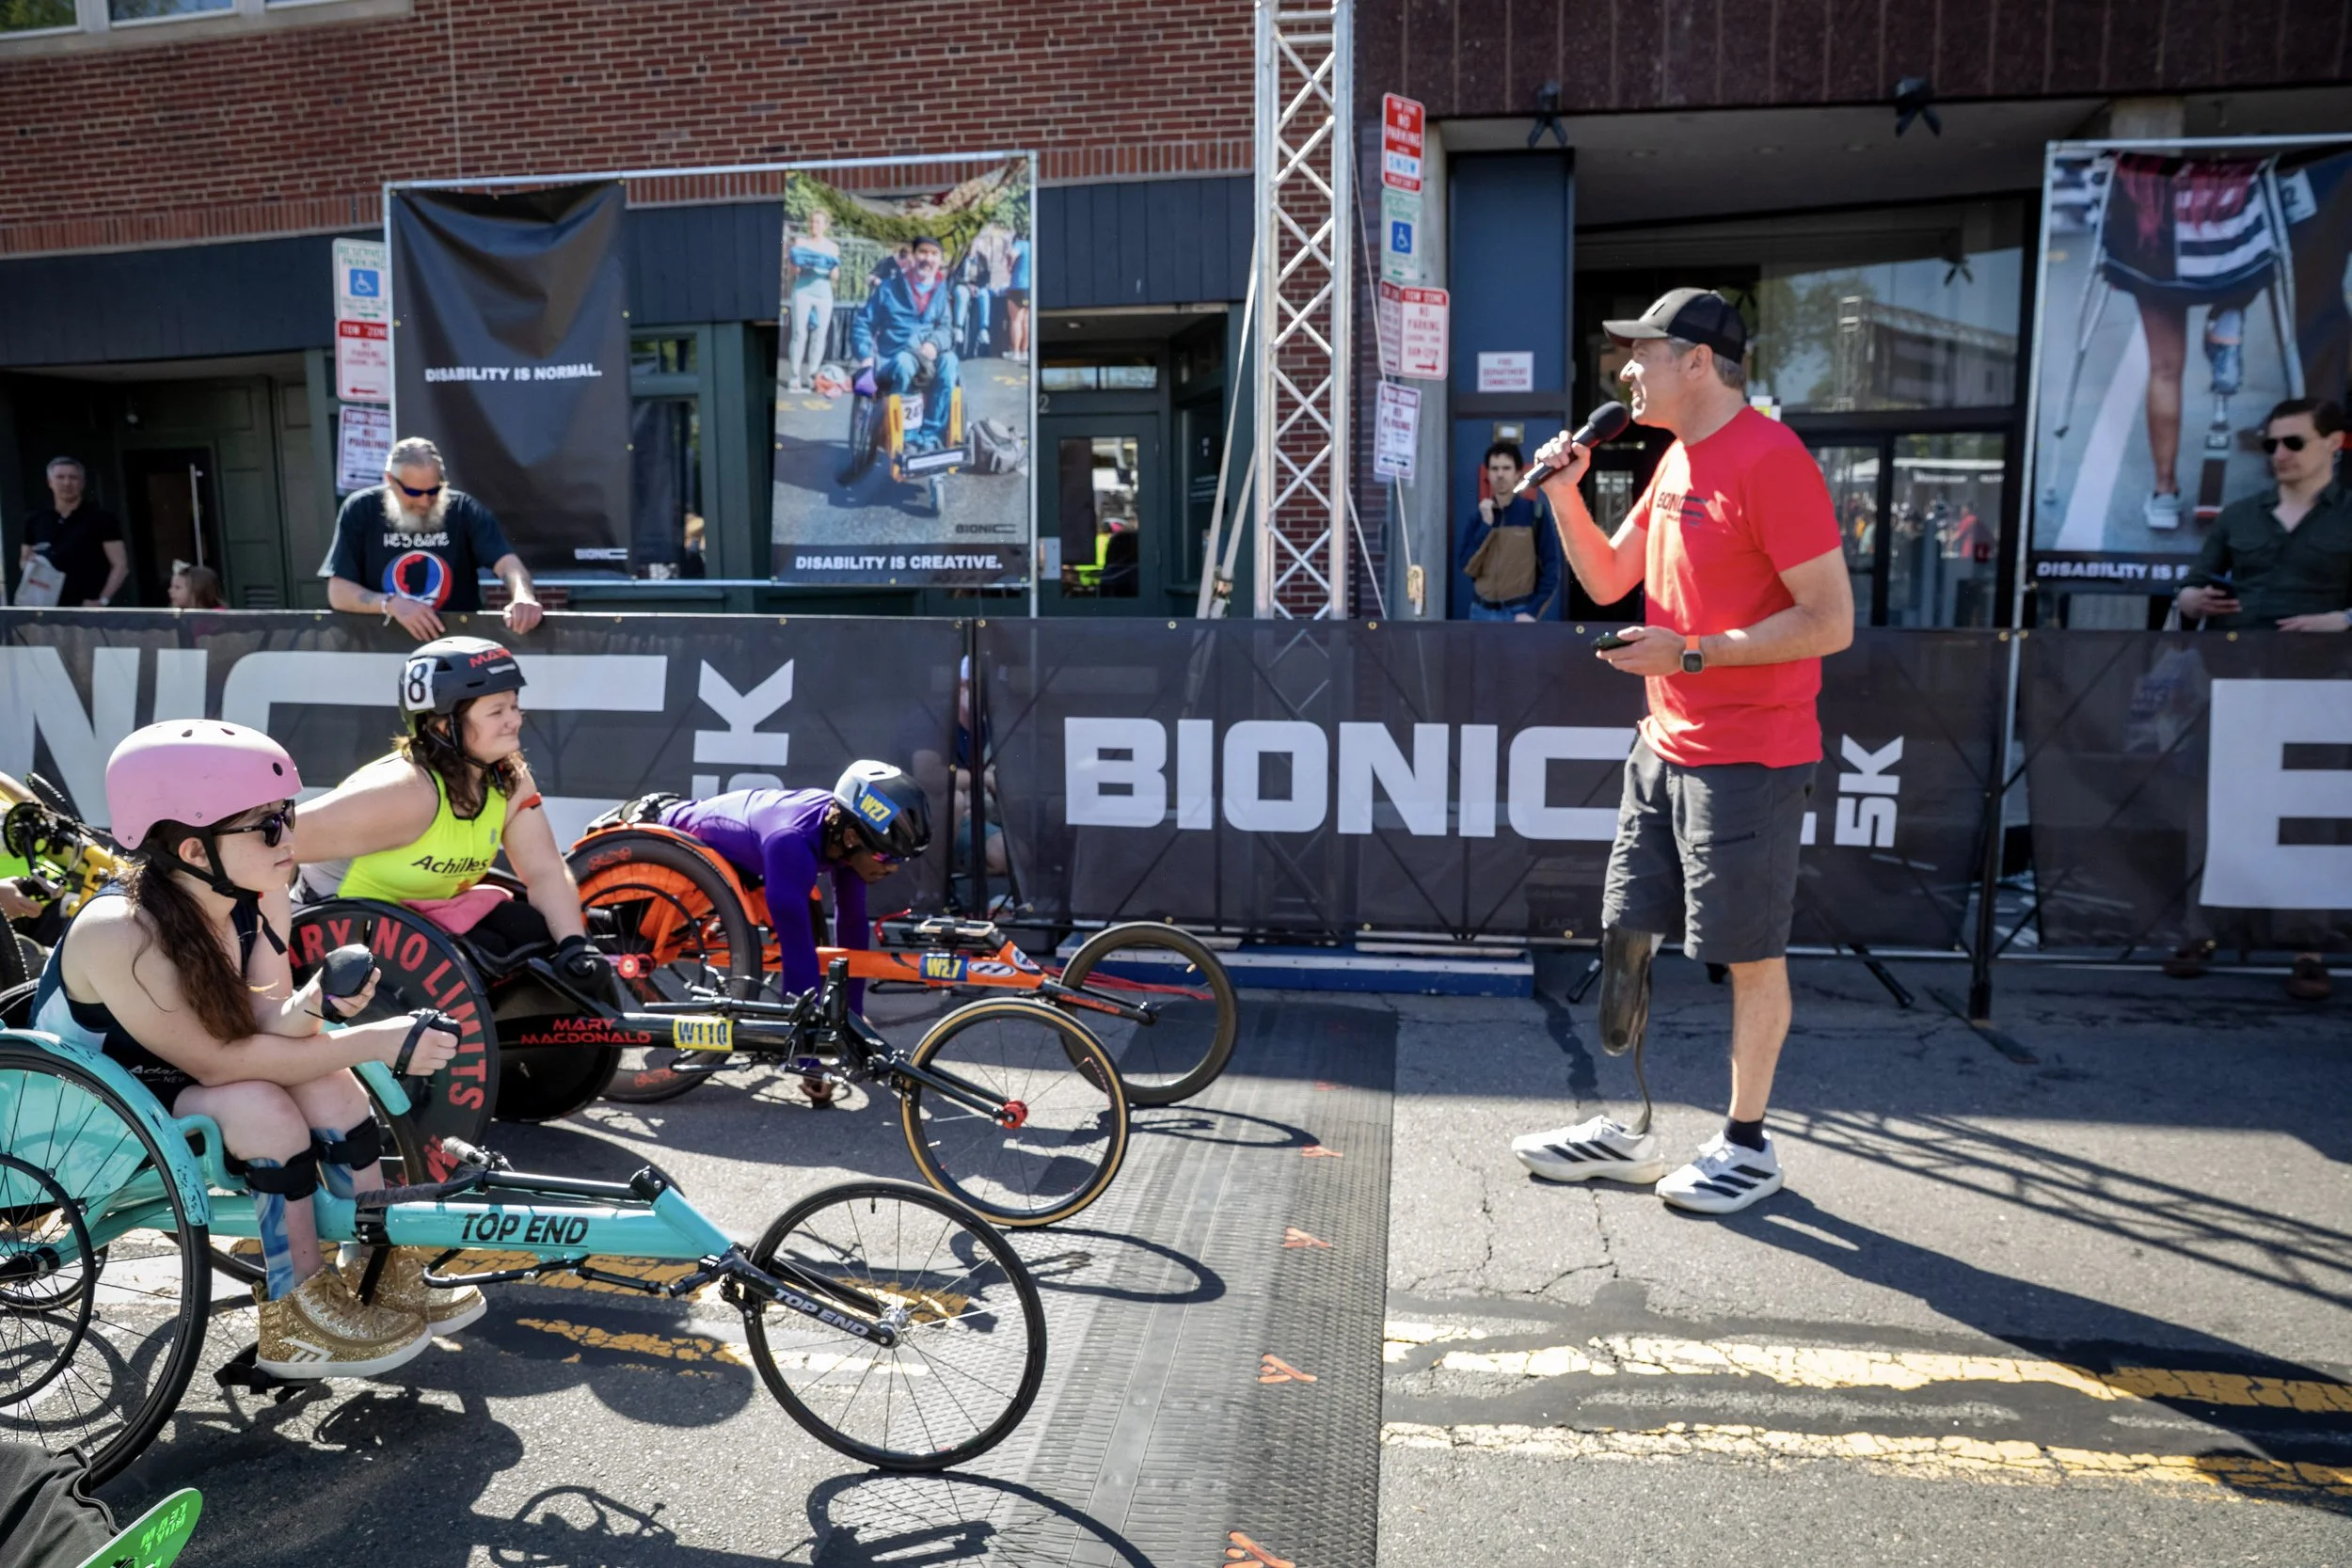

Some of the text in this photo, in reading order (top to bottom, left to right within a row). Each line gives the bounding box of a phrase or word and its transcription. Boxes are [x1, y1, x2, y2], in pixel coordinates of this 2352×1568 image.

[425, 363, 603, 382] DISABILITY IS NORMAL.
[956, 523, 1016, 534] BIONIC
[795, 555, 1003, 570] DISABILITY IS CREATIVE.
[2036, 562, 2148, 579] DISABILITY
[2151, 564, 2172, 580] IS
[408, 663, 427, 704] 8
[1834, 733, 1904, 847] 5K
[860, 793, 891, 822] W27
[411, 855, 489, 874] Achilles
[927, 957, 961, 979] W27
[373, 917, 428, 972] NO
[421, 959, 486, 1110] LIMITS
[553, 1018, 617, 1031] MARY
[520, 1032, 652, 1045] MACDONALD
[678, 1021, 727, 1046] W110
[461, 1212, 589, 1244] TOP END
[775, 1288, 870, 1337] TOP END
